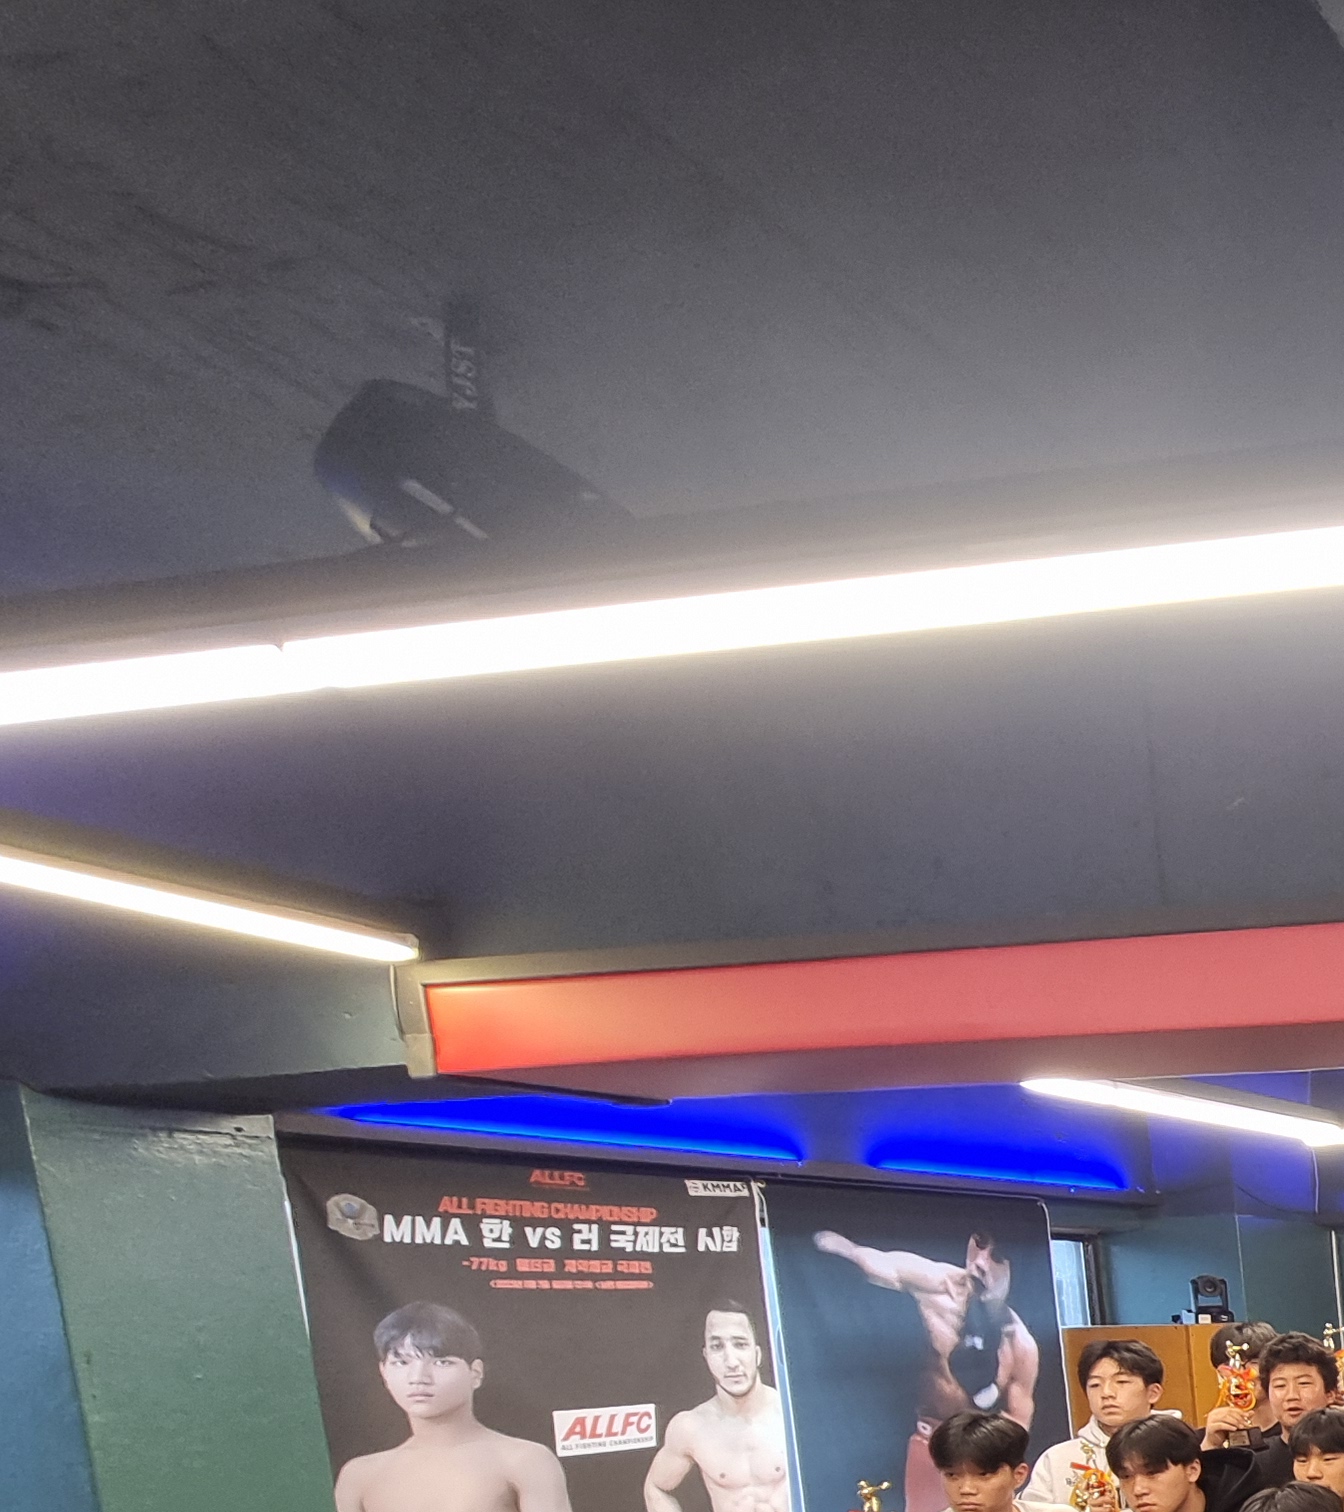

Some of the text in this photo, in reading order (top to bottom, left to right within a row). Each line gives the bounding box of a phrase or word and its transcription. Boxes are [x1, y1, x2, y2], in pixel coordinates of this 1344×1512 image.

[438, 1196, 659, 1222] ALL FIGHTING CHAMPIONSHIP
[383, 1214, 740, 1253] MMA 한 vs 러 국제전 시합
[561, 1411, 653, 1443] ALLFC
